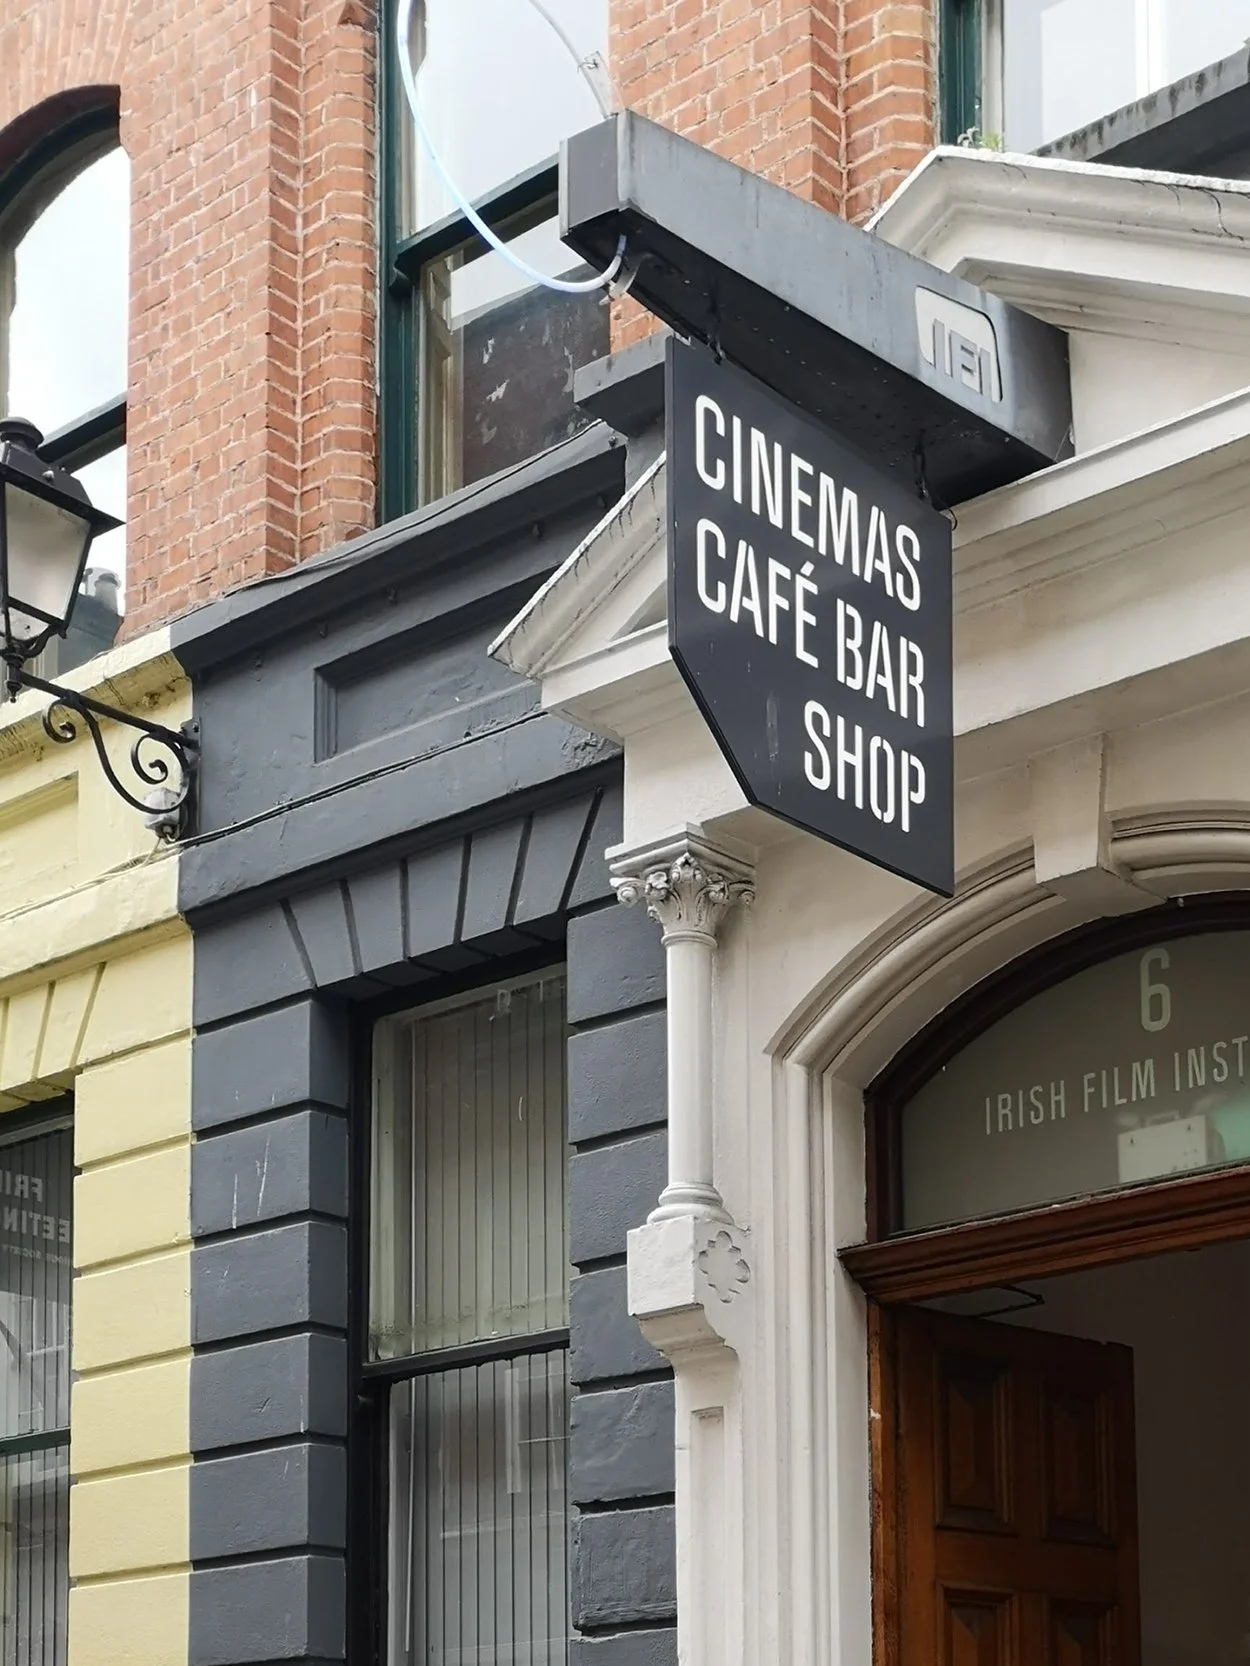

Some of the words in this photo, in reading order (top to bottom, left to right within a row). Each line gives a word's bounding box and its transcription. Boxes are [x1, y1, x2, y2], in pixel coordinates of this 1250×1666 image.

[695, 394, 921, 612] CINEMAS
[695, 517, 820, 669] CAFÉ
[835, 597, 926, 729] BAR
[803, 699, 926, 833] SHOP
[1139, 947, 1172, 1032] 6
[985, 1079, 1067, 1136] IRISH
[1083, 1058, 1156, 1113] FILM
